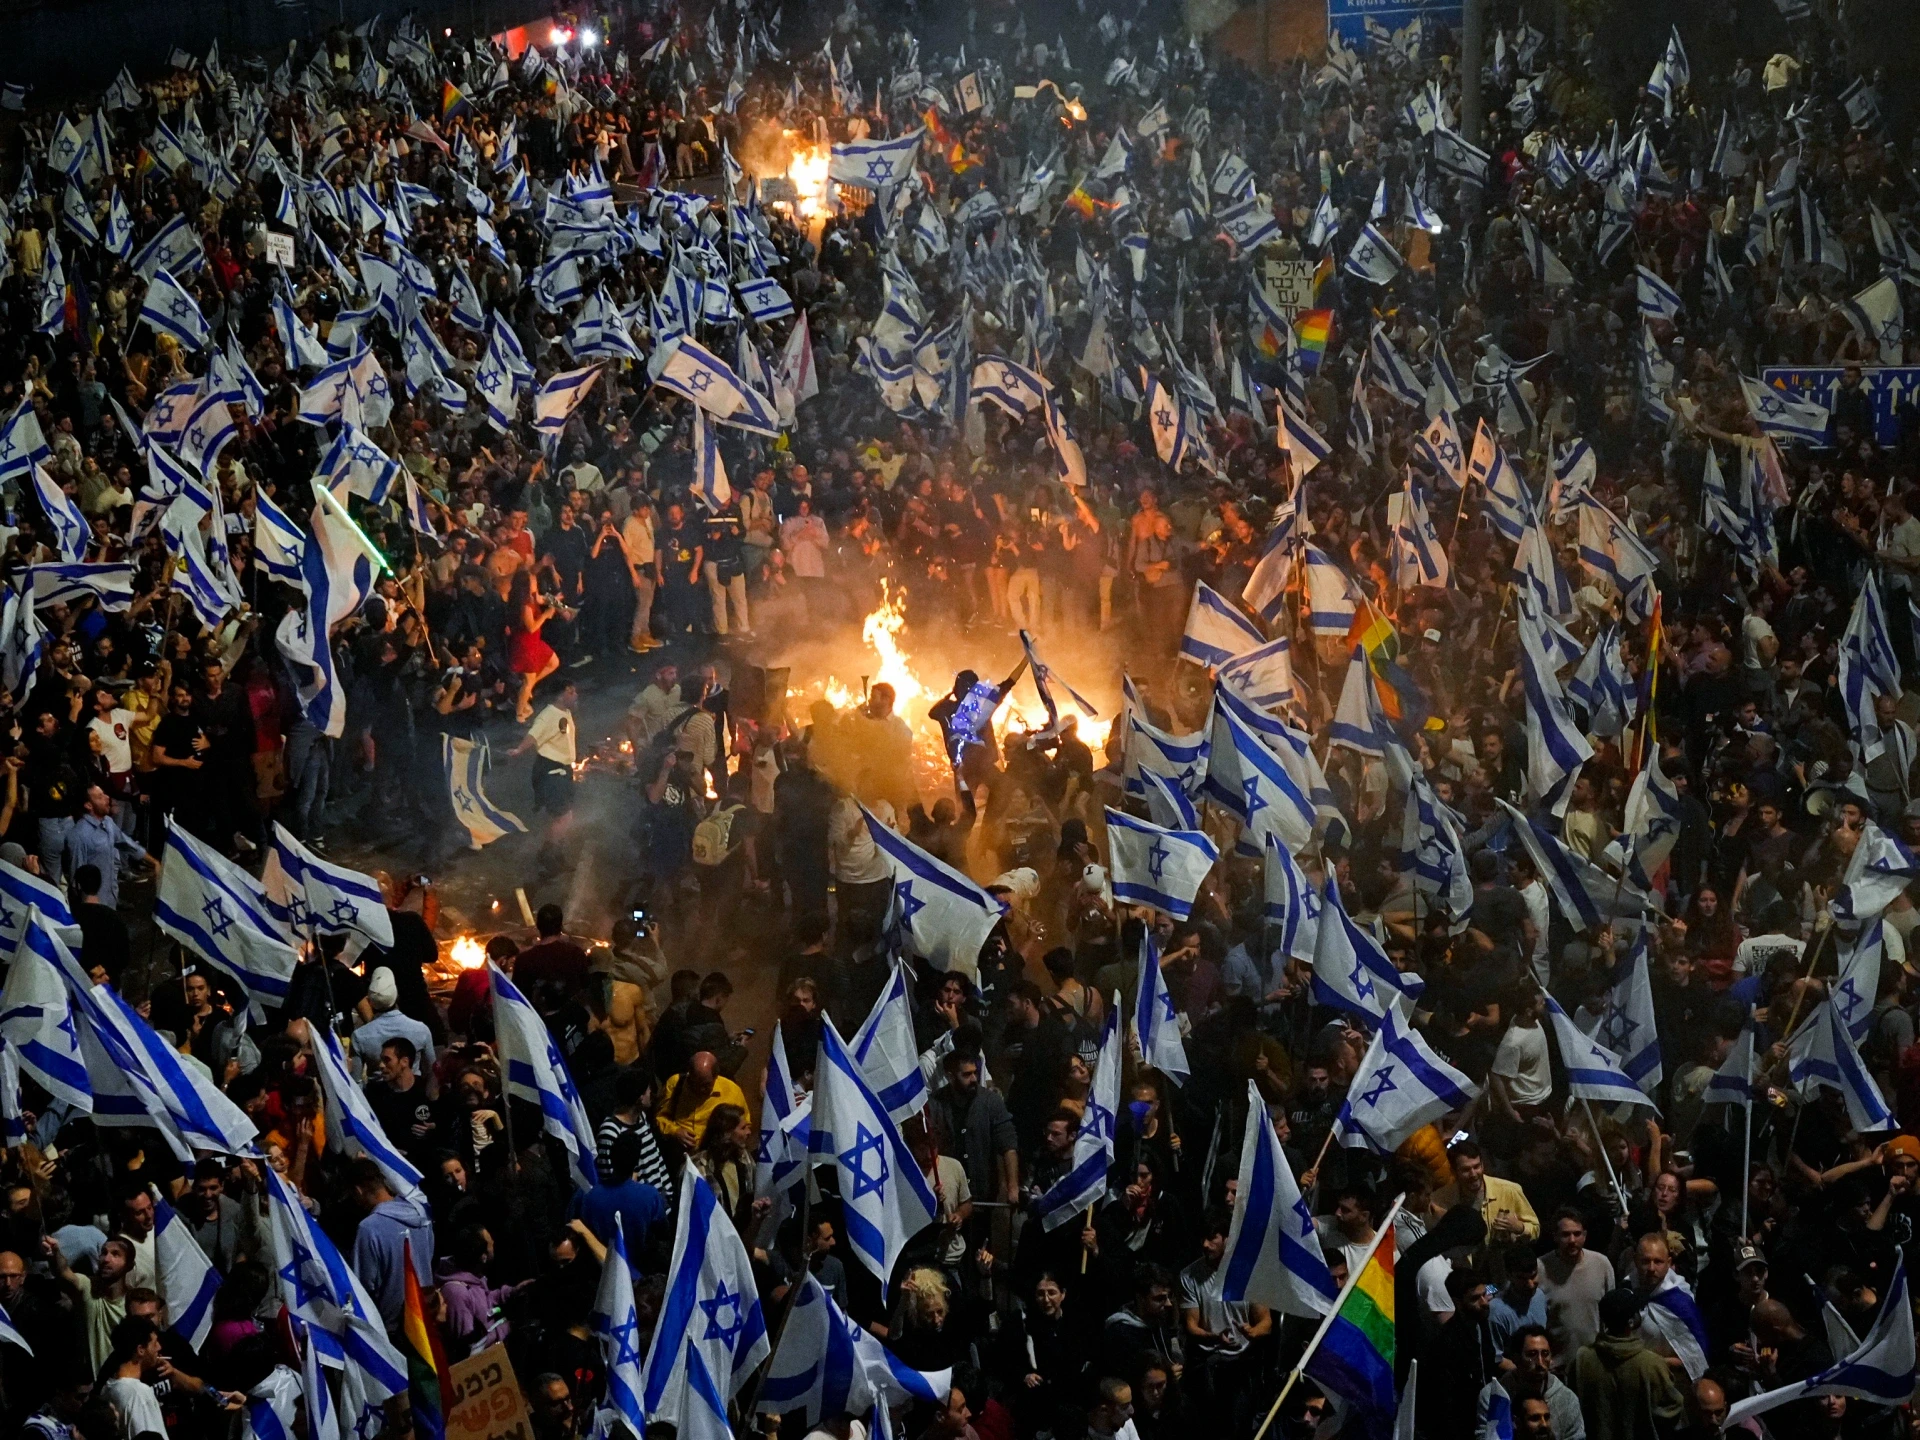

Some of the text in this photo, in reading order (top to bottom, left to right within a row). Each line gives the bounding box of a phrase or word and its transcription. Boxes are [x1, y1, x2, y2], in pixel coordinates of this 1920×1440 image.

[1276, 260, 1306, 276] אולי
[1298, 278, 1312, 290] די
[1278, 290, 1299, 303] עם
